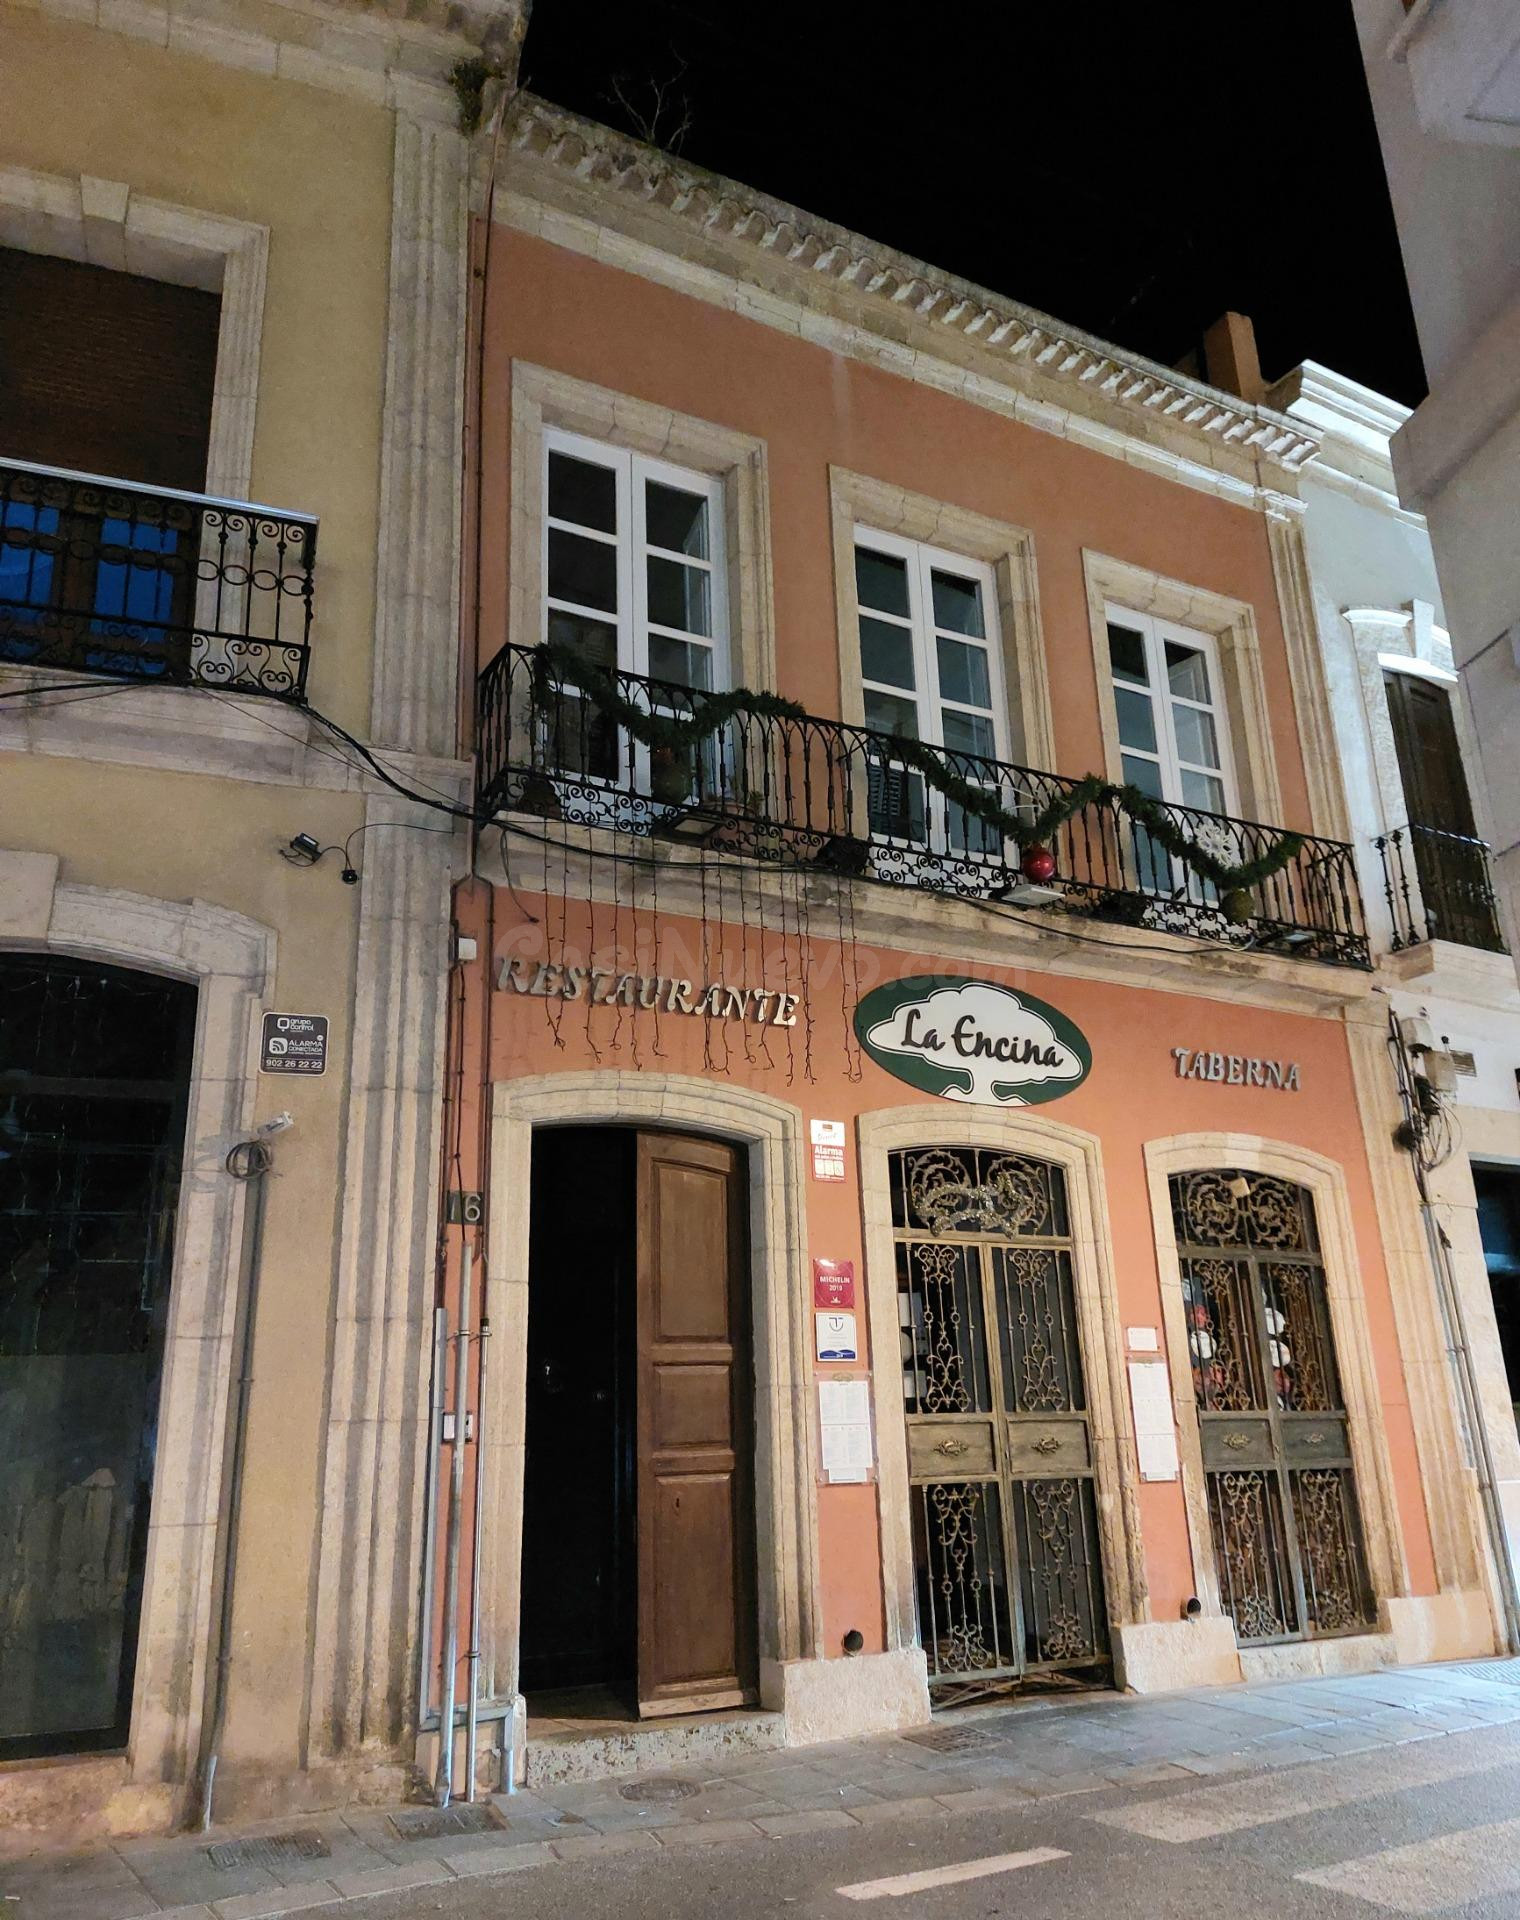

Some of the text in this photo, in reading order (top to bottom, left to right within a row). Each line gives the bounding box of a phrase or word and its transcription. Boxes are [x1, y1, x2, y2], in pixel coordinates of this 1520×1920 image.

[497, 956, 800, 1027] RESTAURANTE
[901, 1008, 1064, 1068] La Encina
[266, 1059, 283, 1067] 902
[311, 1061, 322, 1069] 22
[1172, 1047, 1301, 1092] TABERNA
[814, 1145, 844, 1156] Alarma
[450, 1194, 482, 1221] 16
[819, 1276, 850, 1284] MICHELIN
